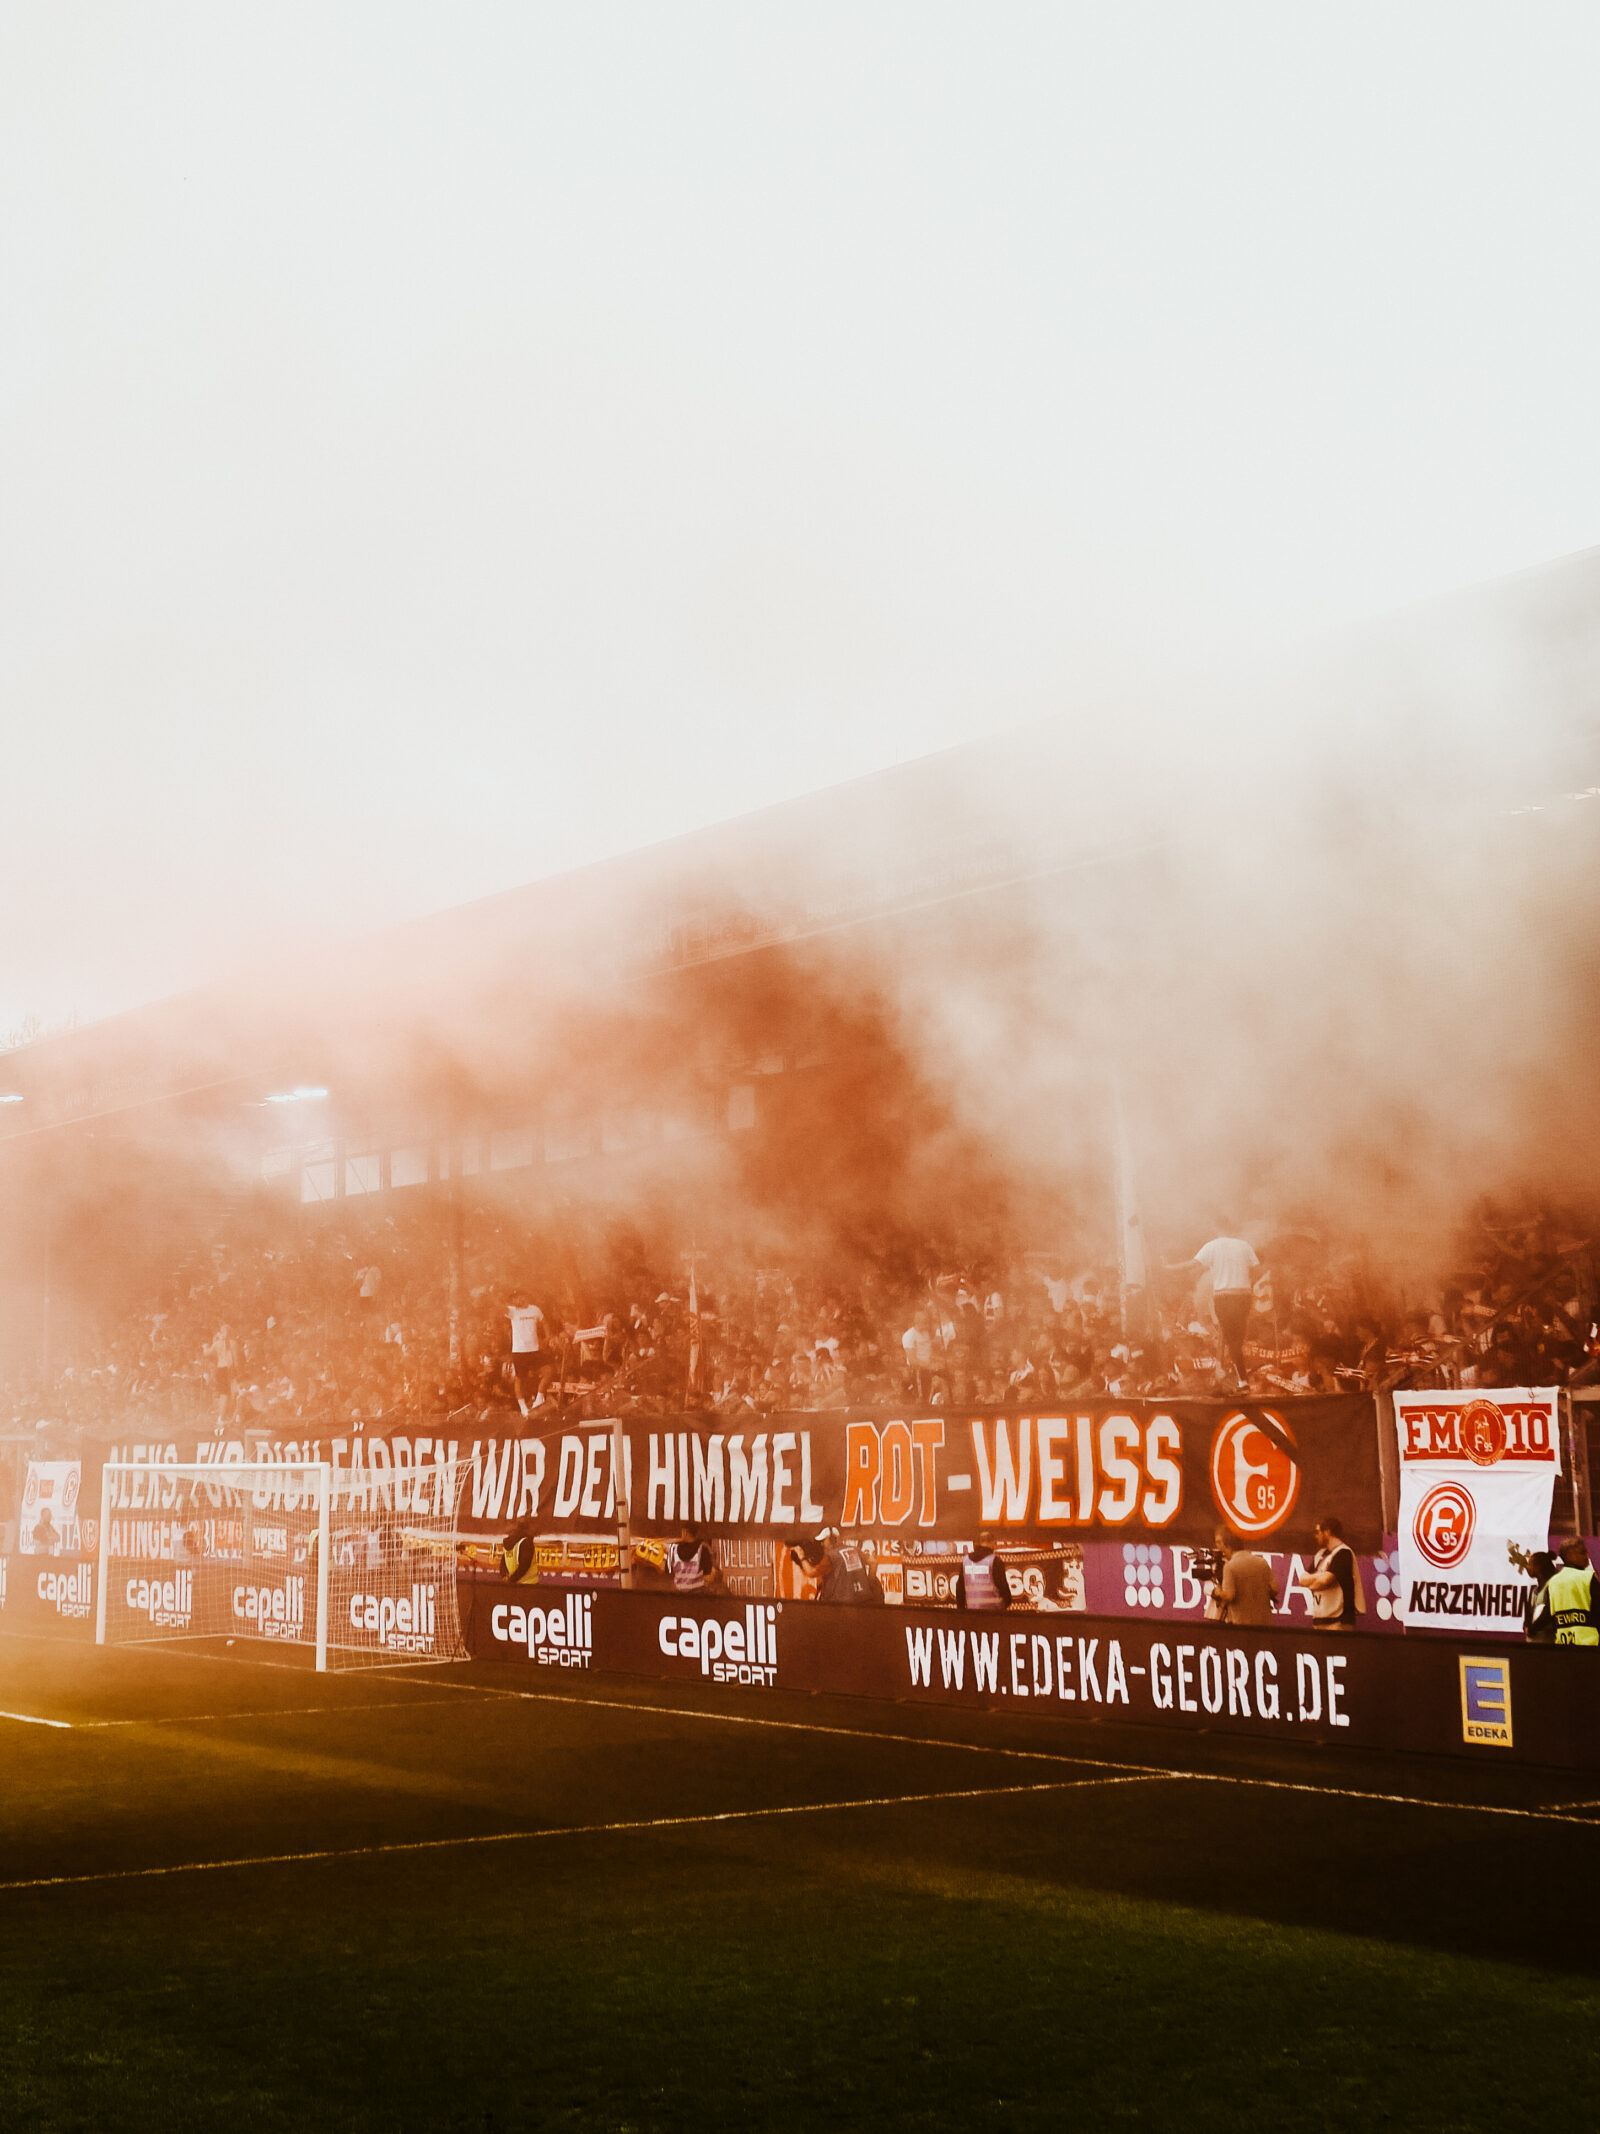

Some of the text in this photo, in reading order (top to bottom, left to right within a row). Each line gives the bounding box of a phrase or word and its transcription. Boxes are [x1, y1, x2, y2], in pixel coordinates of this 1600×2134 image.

[1403, 1410, 1550, 1454] FM 10
[189, 1428, 245, 1508] FÜR
[251, 1440, 324, 1511] DICH
[330, 1421, 459, 1517] FÄRBEN
[470, 1438, 546, 1520] WIR
[553, 1434, 632, 1519] DEN
[647, 1431, 824, 1524] HIMMEL
[841, 1414, 1183, 1527] ROT-WEISS
[38, 1563, 92, 1612] capelli
[61, 1603, 91, 1618] SPORT
[126, 1570, 192, 1621] capelli
[233, 1576, 304, 1632] capelli
[155, 1612, 191, 1629] SPORT
[265, 1621, 304, 1640] SPORT
[350, 1584, 434, 1644] capelli
[491, 1593, 592, 1658] capelli
[387, 1633, 435, 1653] SPORT
[538, 1647, 592, 1669] SPORT
[659, 1604, 777, 1675] capelli
[712, 1663, 778, 1686] SPORT
[905, 1627, 1350, 1727] WWW.EDEKA-GEORG.DE
[1467, 1726, 1509, 1740] EDEKA
